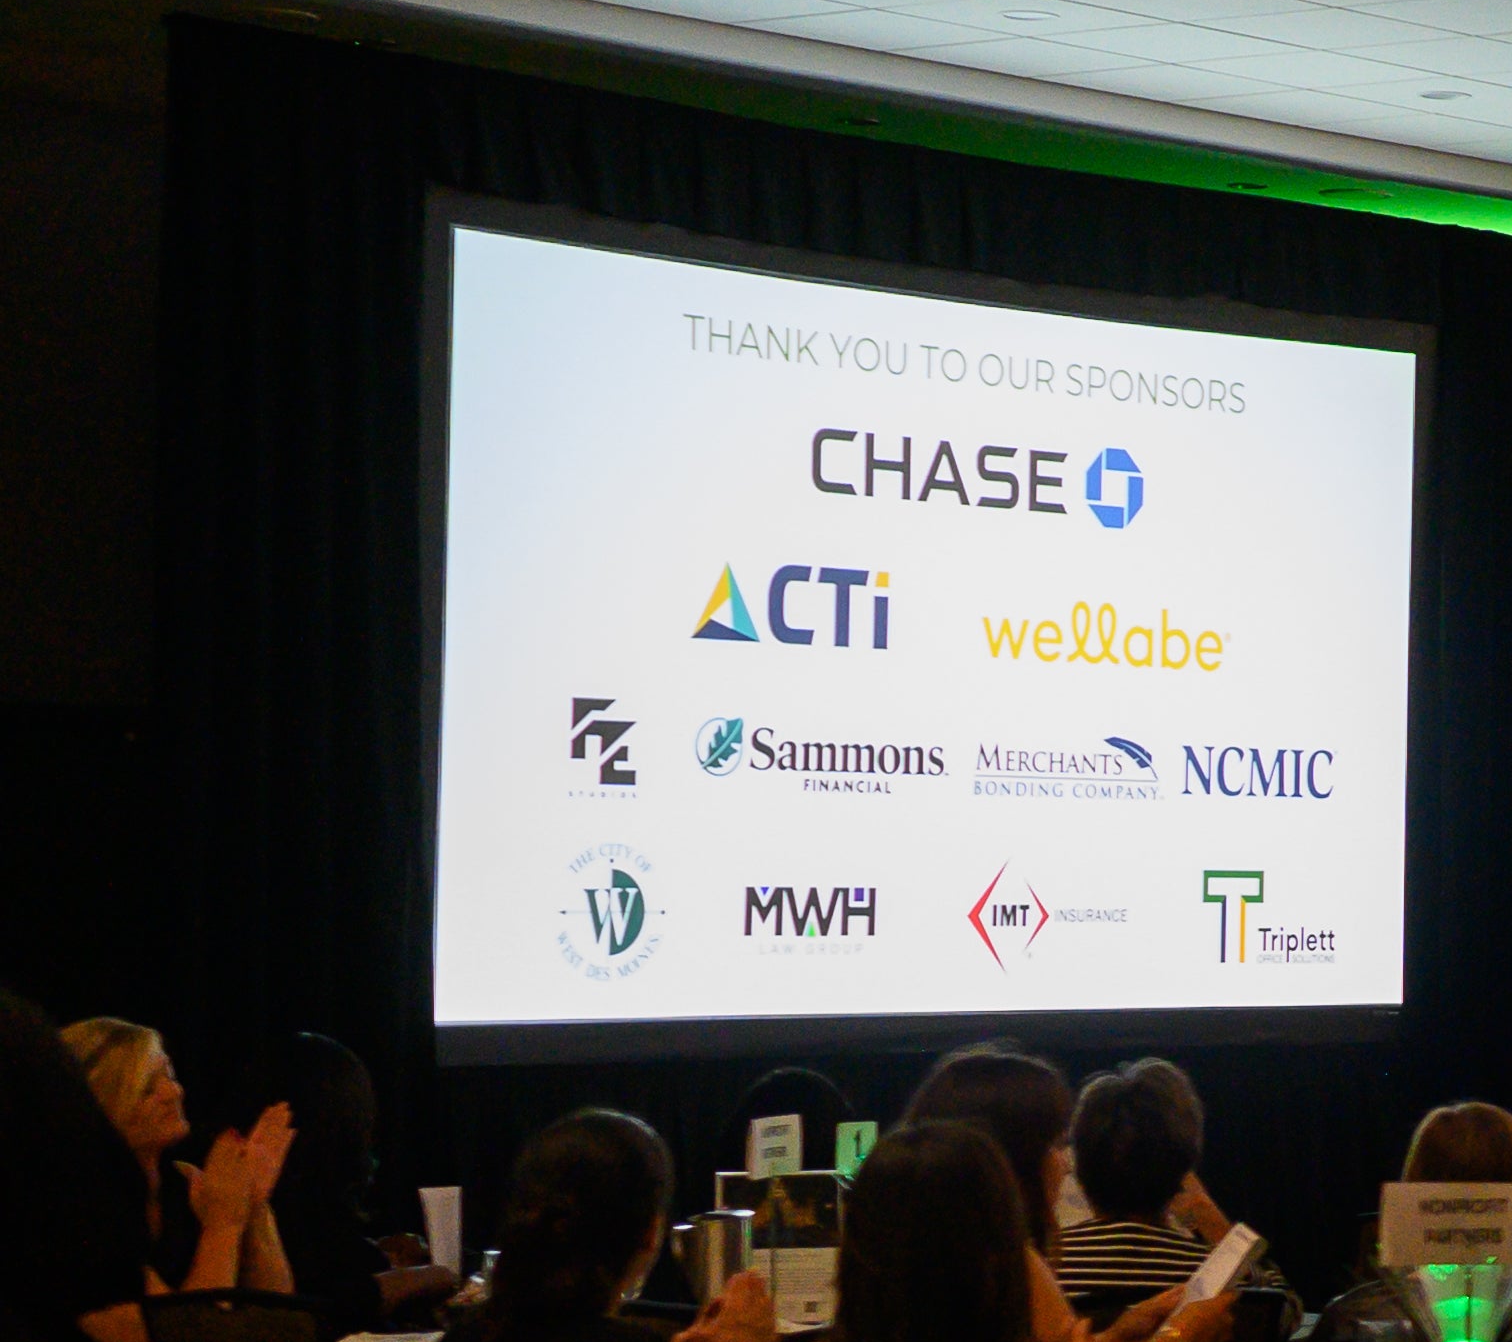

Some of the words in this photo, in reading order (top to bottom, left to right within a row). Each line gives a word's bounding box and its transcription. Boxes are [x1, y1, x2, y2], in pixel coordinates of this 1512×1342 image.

[682, 313, 819, 366] THANK
[829, 332, 908, 375] YOU
[919, 344, 967, 382] TO
[978, 353, 1055, 394] OUR
[1066, 363, 1246, 414] SPONSORS
[811, 427, 1069, 514] CHASE
[768, 563, 891, 650] CTi
[981, 600, 1226, 672] wellabe
[750, 726, 946, 777] Sammons
[1182, 745, 1335, 799] NCMIC
[803, 778, 892, 795] FINANCIAL
[974, 780, 1064, 799] BONDING
[1072, 783, 1160, 801] COMPANY
[598, 842, 633, 859] CITY
[744, 886, 877, 937] MWH
[992, 903, 1030, 927] IMT
[1053, 908, 1128, 923] INSURANCE
[758, 943, 795, 956] LAW
[805, 943, 865, 956] GROUP
[1258, 926, 1335, 963] Triplett
